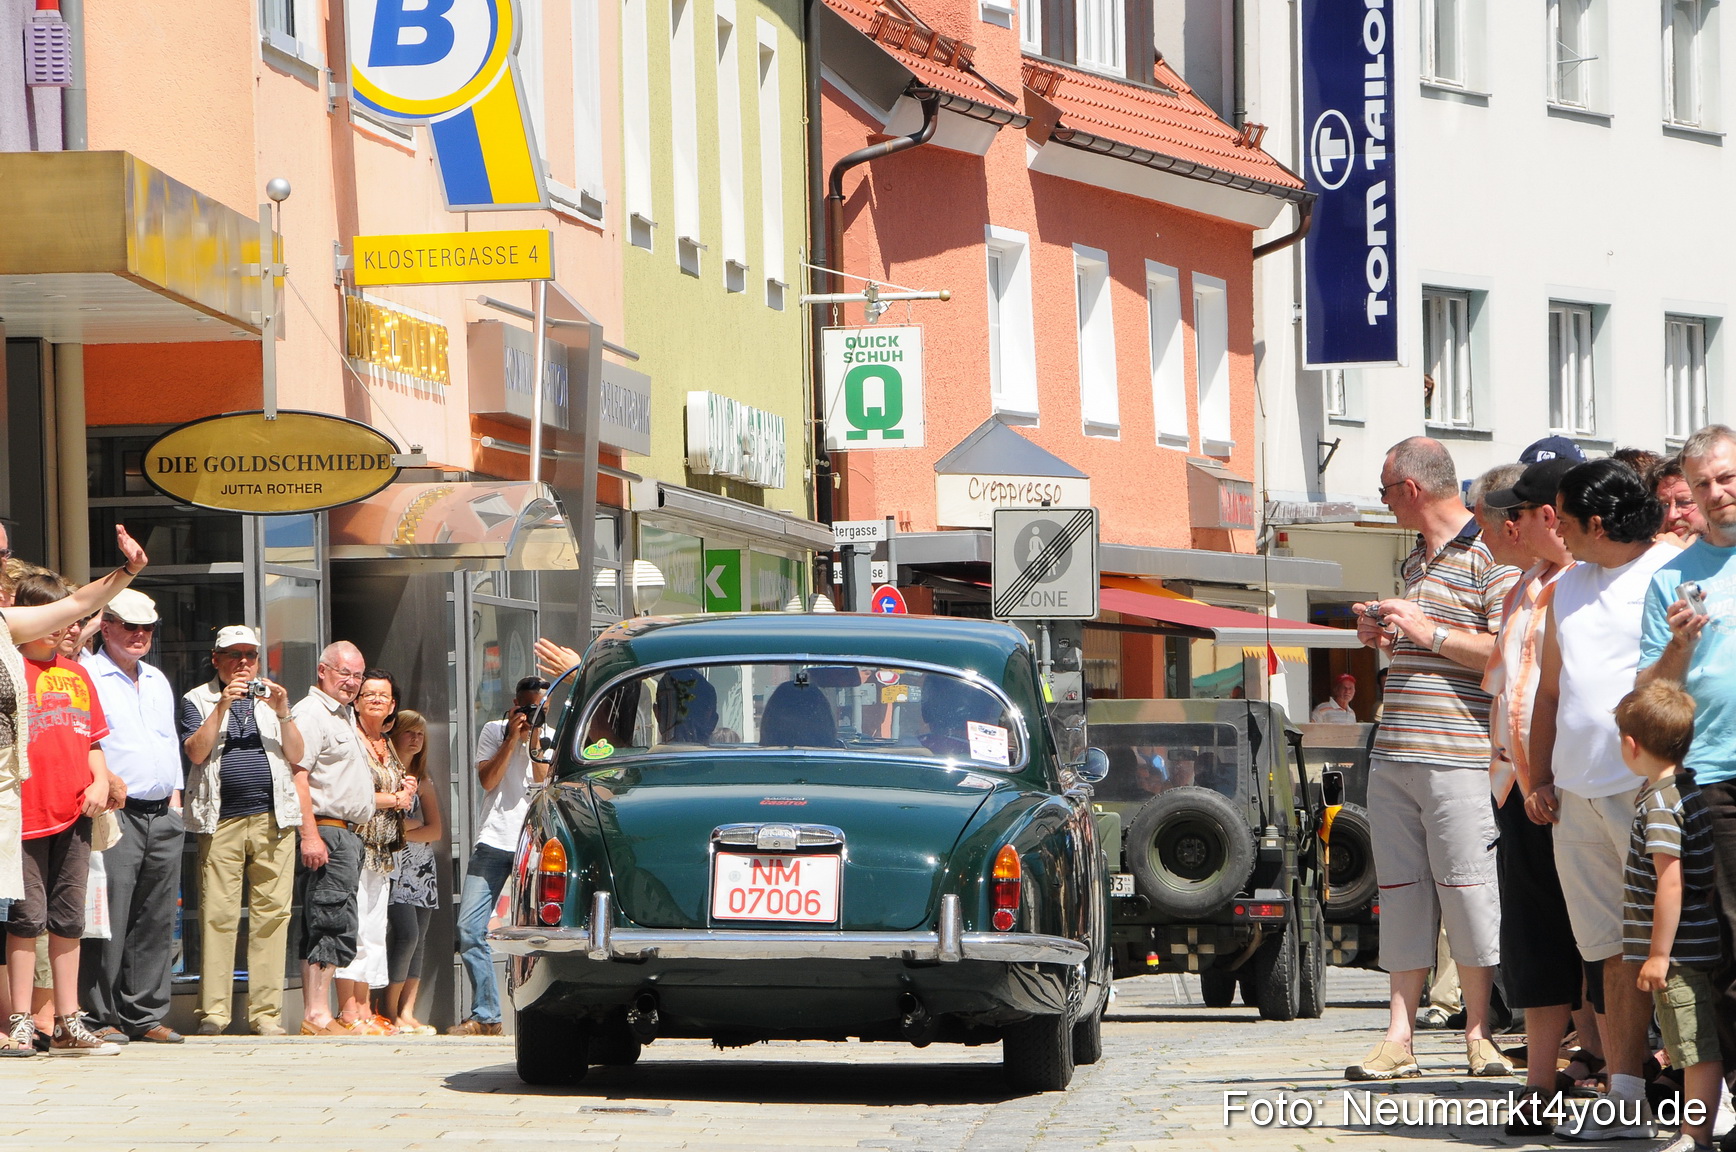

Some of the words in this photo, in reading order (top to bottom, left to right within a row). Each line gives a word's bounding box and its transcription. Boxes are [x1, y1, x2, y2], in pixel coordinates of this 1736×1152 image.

[1363, 0, 1386, 170] TAILO
[364, 245, 519, 269] KLOSTERGASSE
[528, 245, 538, 263] 4
[1365, 180, 1388, 326] TOM
[845, 335, 900, 350] QUICK
[843, 350, 903, 363] SCHUH
[157, 456, 198, 474] DIE
[203, 453, 390, 473] GOLDSCHMIEDE
[220, 484, 263, 495] JUTTA
[267, 483, 323, 494] ROTHER
[968, 477, 1062, 507] Creppresso
[1020, 590, 1068, 607] ZONE
[752, 859, 800, 886] NM
[729, 887, 821, 915] 07006
